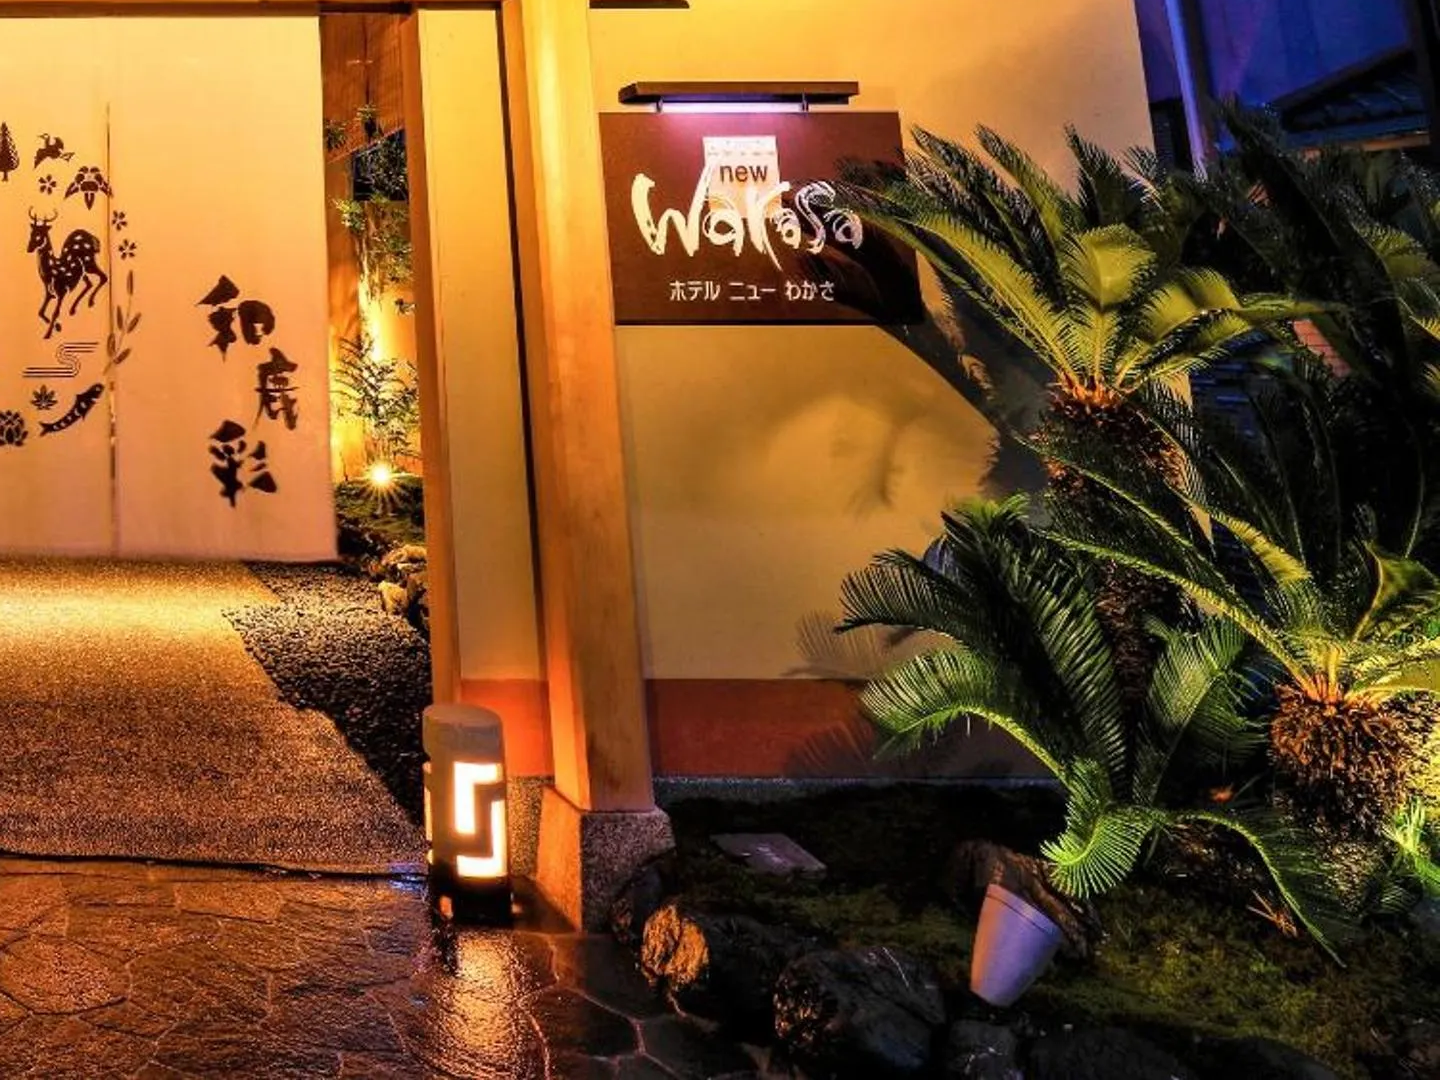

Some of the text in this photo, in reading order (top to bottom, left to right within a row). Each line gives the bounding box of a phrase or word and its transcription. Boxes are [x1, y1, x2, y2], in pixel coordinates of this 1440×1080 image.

[720, 165, 768, 183] new
[669, 281, 835, 302] ホテル ニュー わかさ
